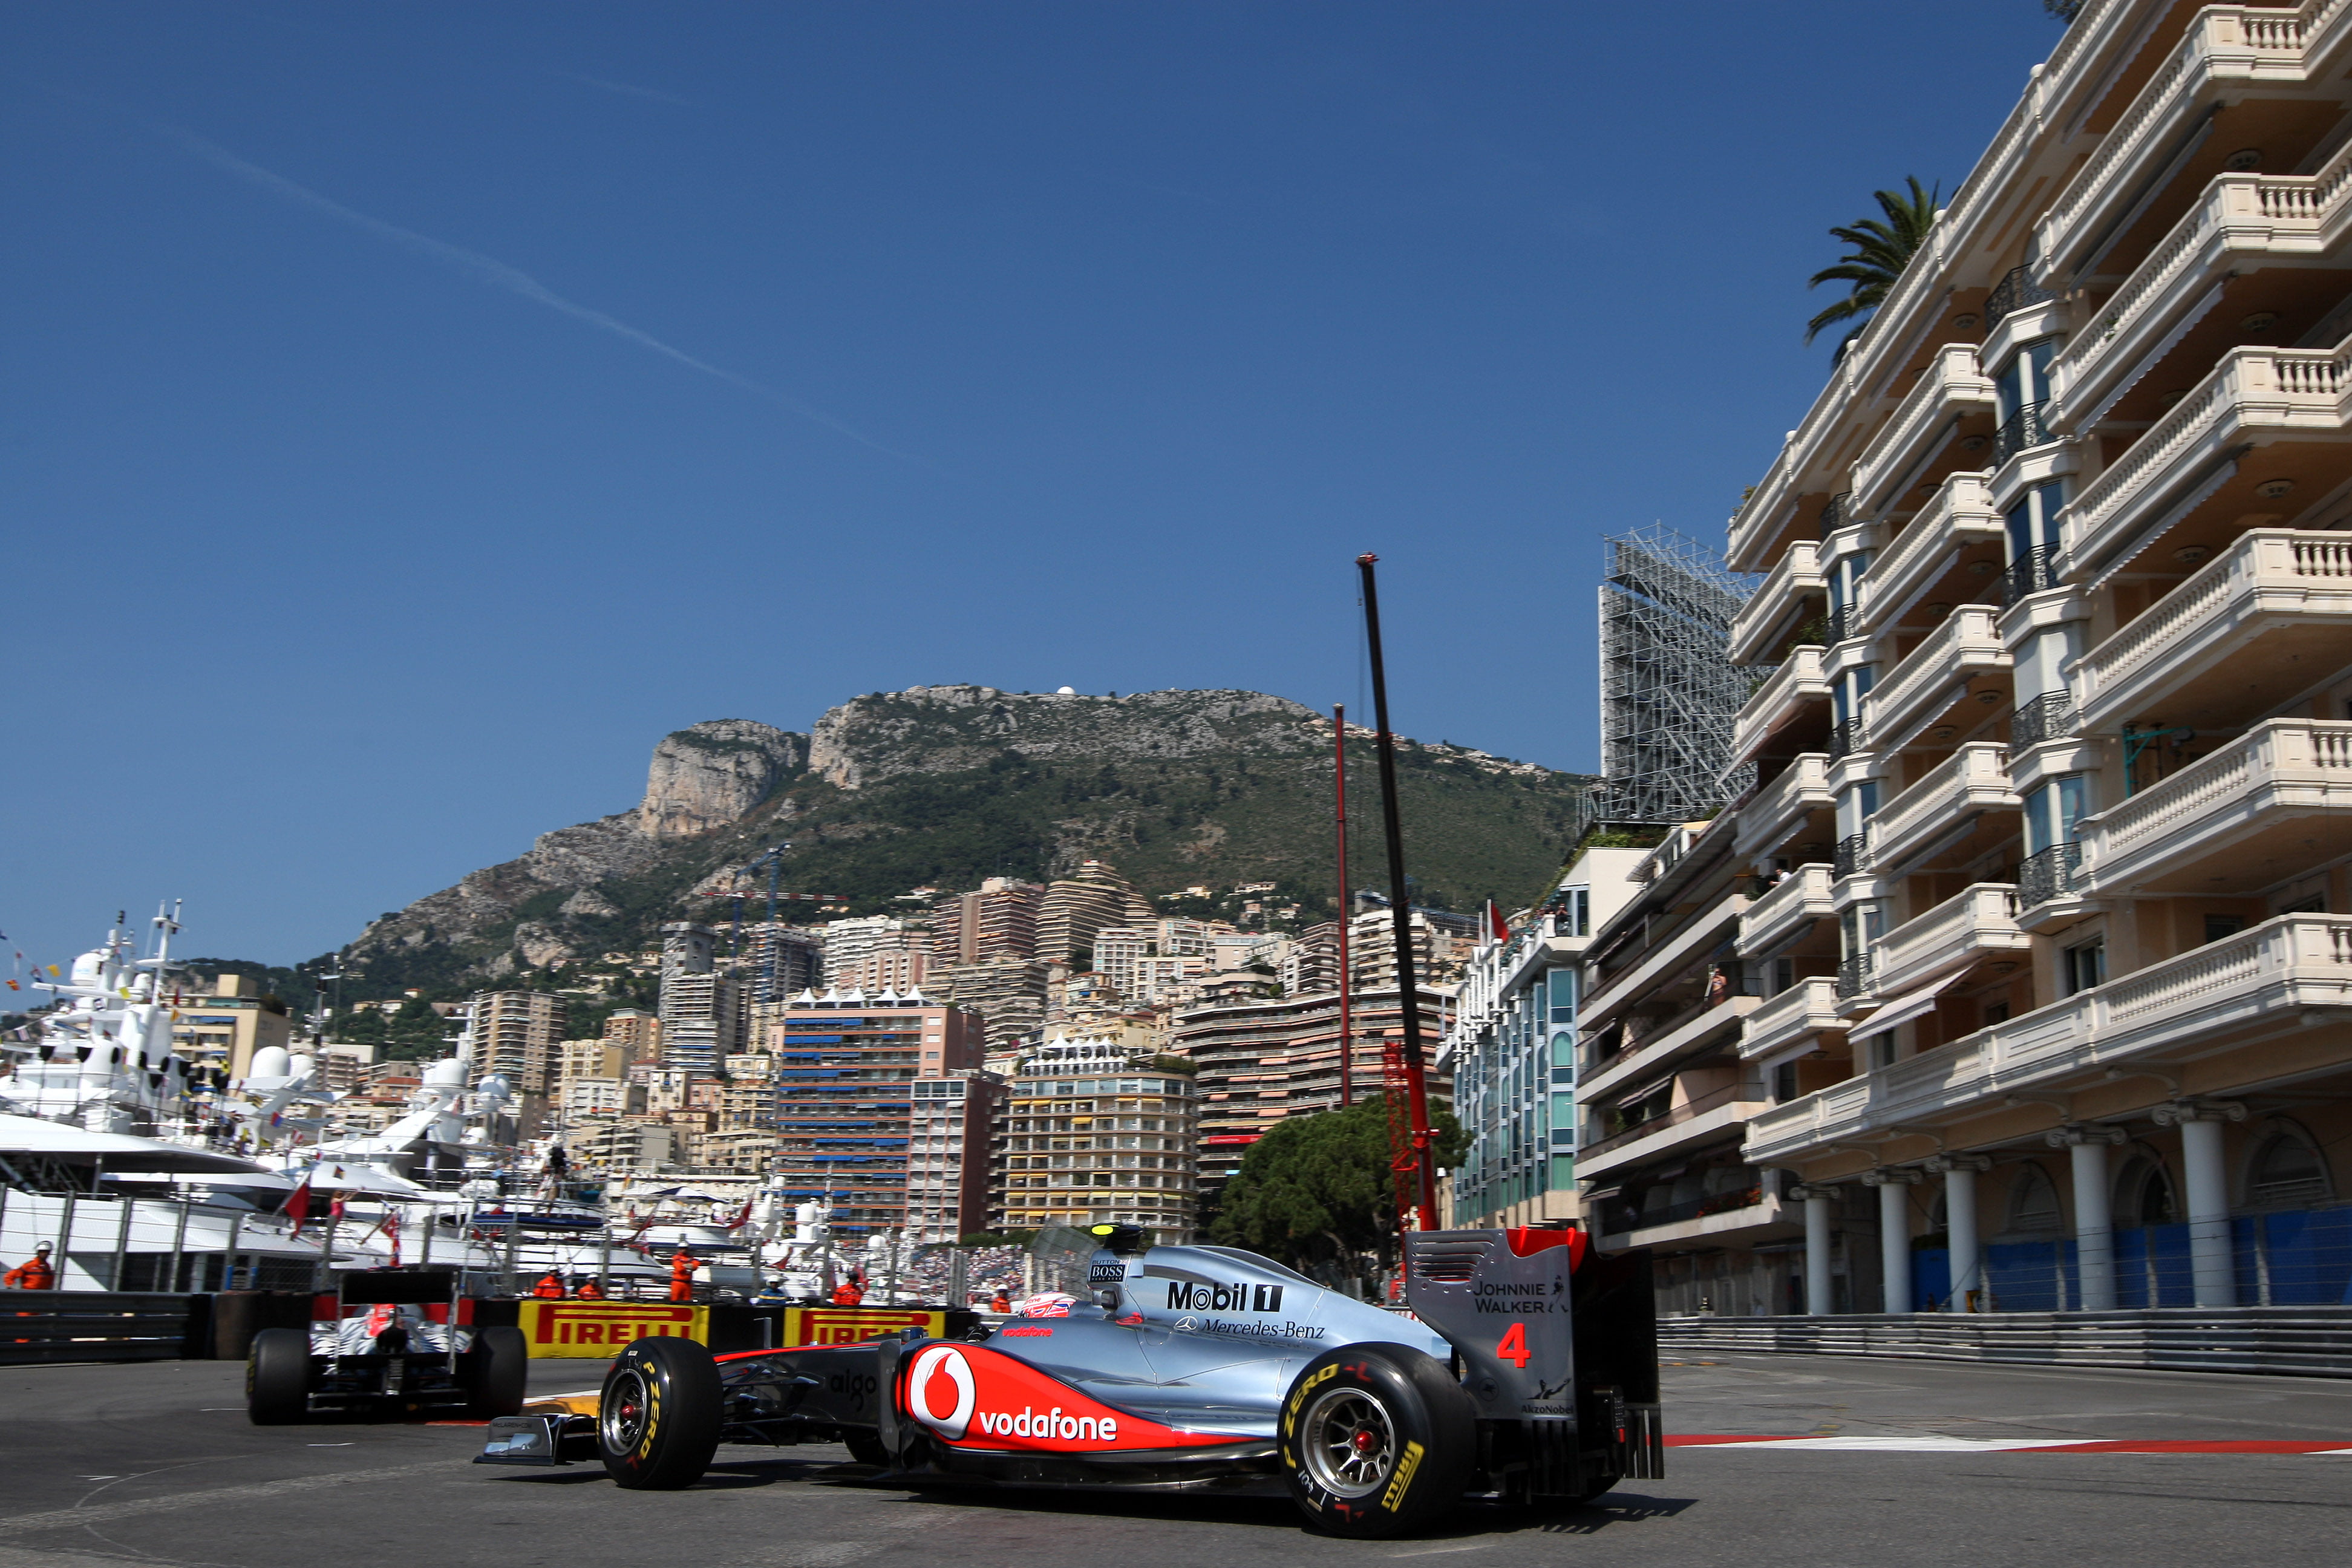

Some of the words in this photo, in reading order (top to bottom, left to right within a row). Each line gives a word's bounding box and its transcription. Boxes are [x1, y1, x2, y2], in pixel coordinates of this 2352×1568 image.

[1092, 1266, 1123, 1276] BOSS
[1167, 1282, 1247, 1311] Mobil
[1473, 1281, 1546, 1296] JOHNNIE
[1475, 1298, 1545, 1313] WALKER
[535, 1304, 694, 1344] PIRELLI
[1002, 1325, 1054, 1337] vodafone
[1201, 1319, 1325, 1339] Mercedes-Benz
[1497, 1323, 1531, 1368] 4
[643, 1362, 656, 1374] P
[1284, 1363, 1340, 1439] ZERO
[1521, 1405, 1573, 1414] AkzoNobel
[639, 1381, 661, 1460] ZERO
[980, 1406, 1118, 1441] vodafone
[1381, 1440, 1425, 1512] PIRELLI
